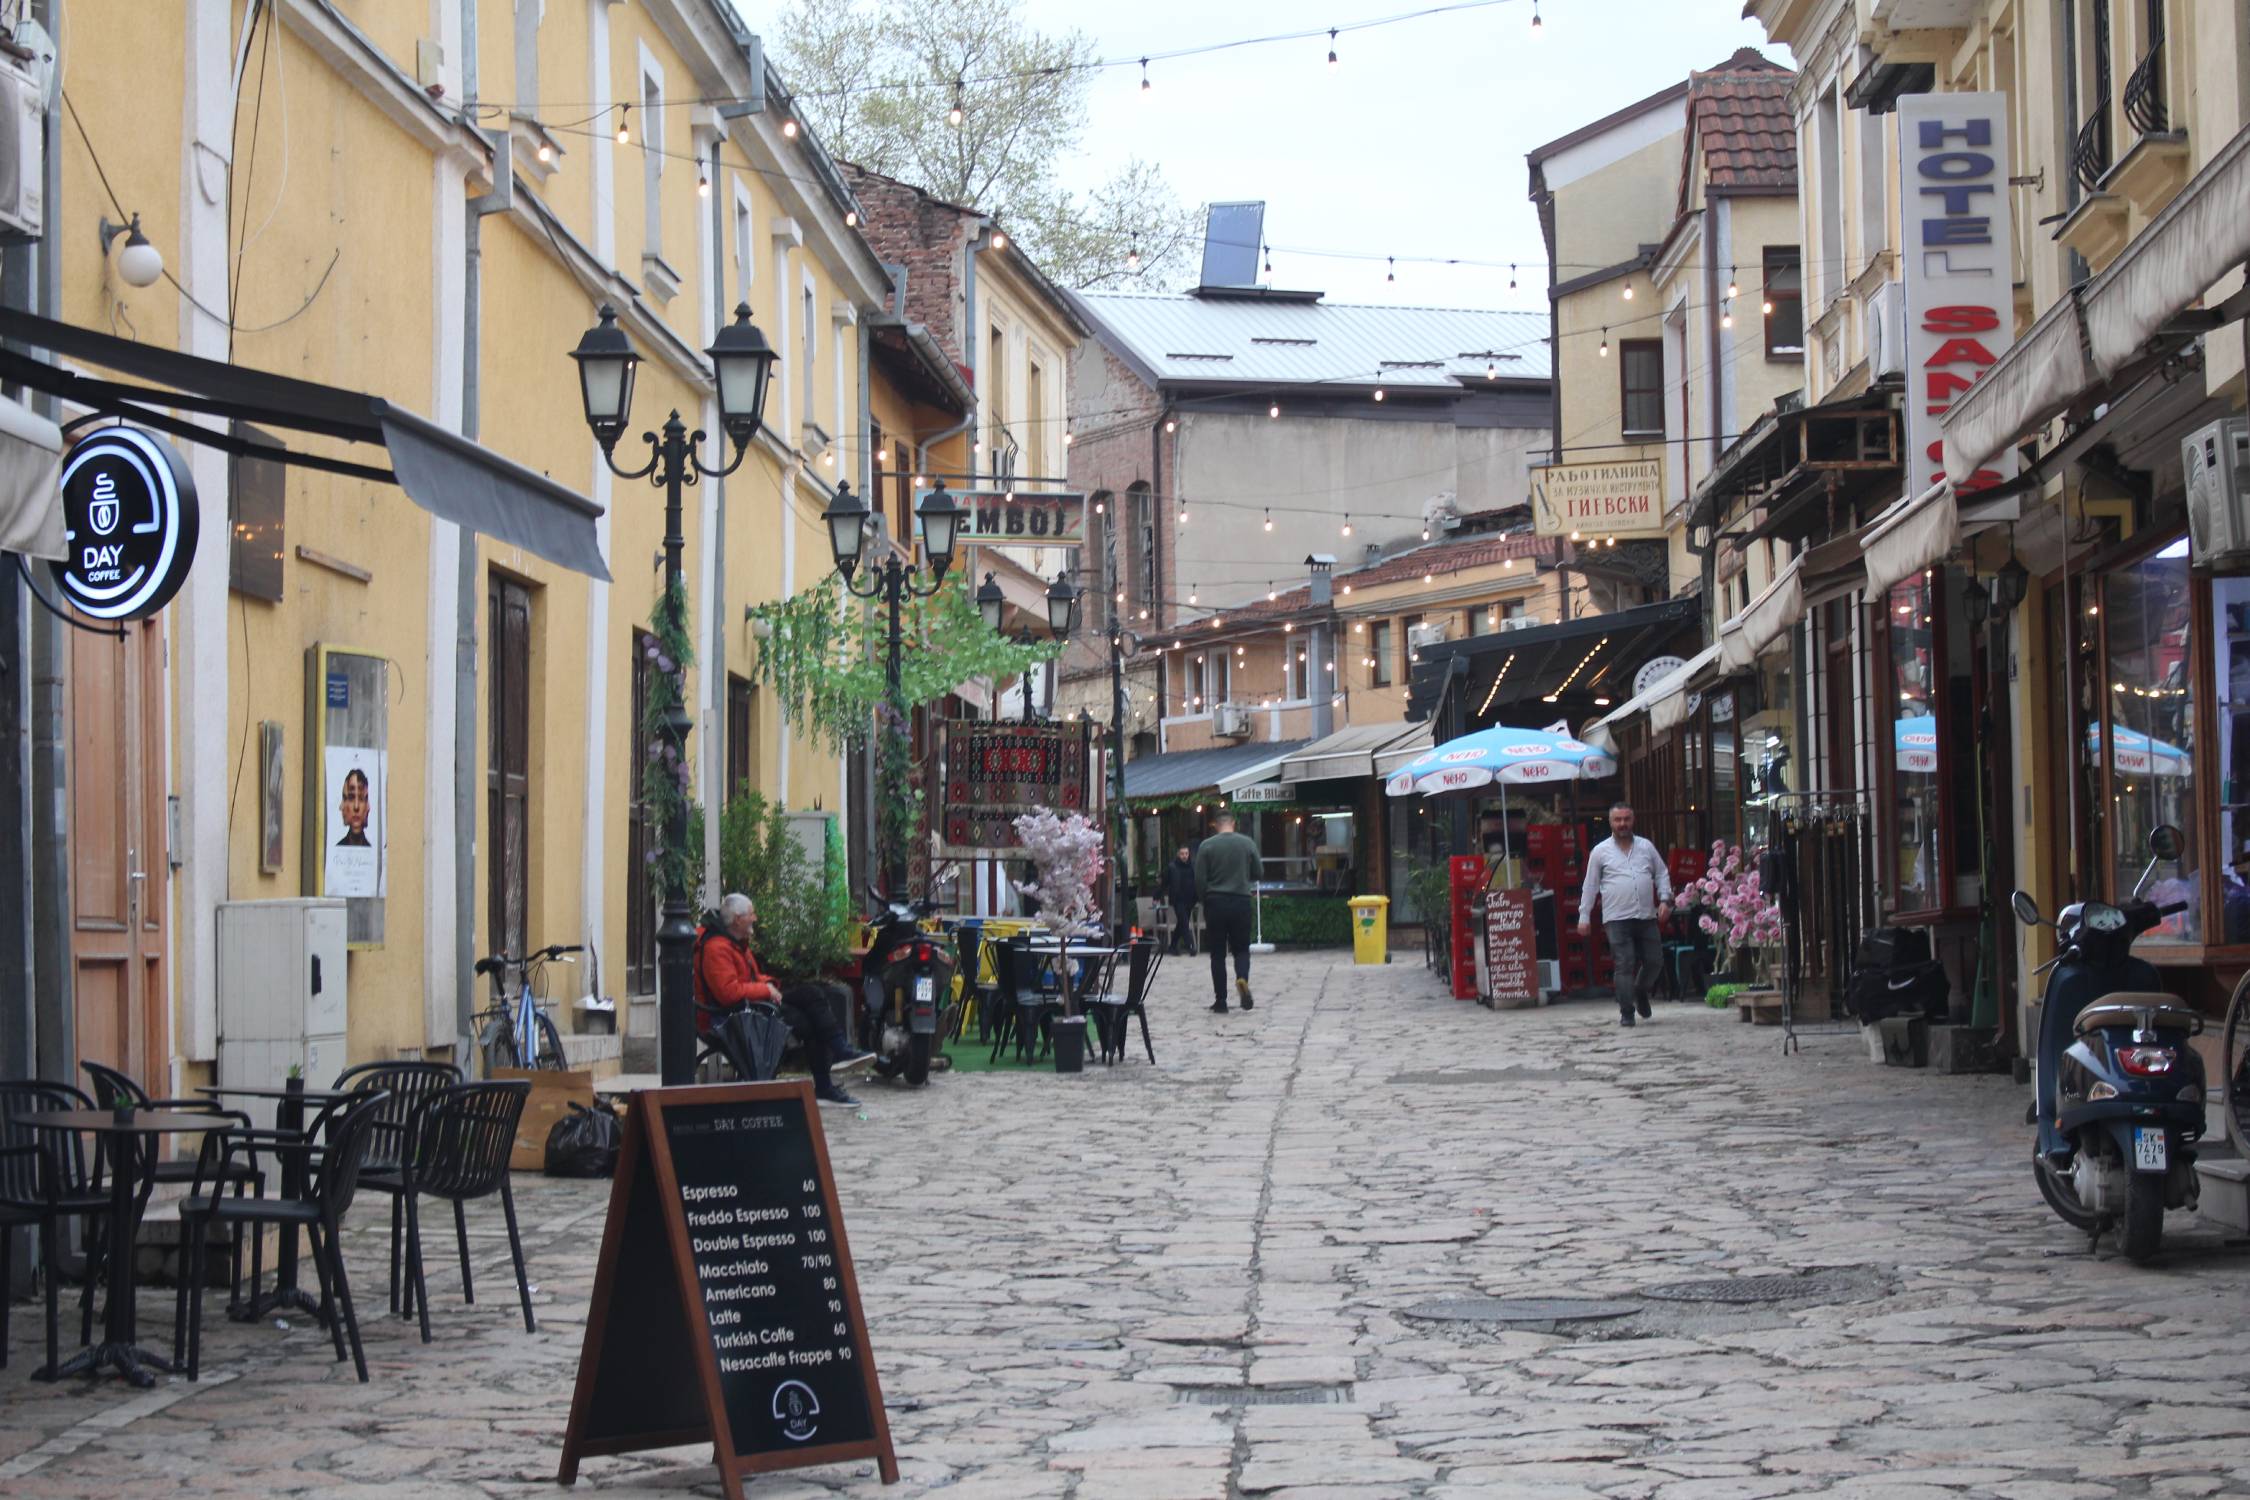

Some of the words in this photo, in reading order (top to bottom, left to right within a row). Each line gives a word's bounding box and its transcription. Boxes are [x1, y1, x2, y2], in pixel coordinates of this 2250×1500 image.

[1918, 119, 1994, 279] HOTEL
[1568, 495, 1649, 517] ГИЕВСКИ
[84, 544, 124, 569] DAY
[88, 569, 120, 582] COFFEE
[714, 1118, 735, 1131] DAY
[741, 1115, 784, 1130] COFFEE
[682, 1184, 738, 1202] Espresso
[802, 1179, 815, 1193] 60
[688, 1209, 733, 1227] Freddo
[736, 1207, 789, 1224] Espresso
[802, 1204, 821, 1218] 100
[693, 1234, 740, 1253] Double
[742, 1232, 796, 1250] Espresso
[807, 1229, 827, 1243] 100
[700, 1259, 769, 1279] Macchiato
[801, 1254, 832, 1270] 70/90
[706, 1284, 776, 1303] Americano
[823, 1276, 837, 1291] 80
[709, 1308, 741, 1326] Latte
[828, 1299, 842, 1313] 90
[713, 1330, 758, 1350] Turkish
[760, 1326, 795, 1344] Coffe
[833, 1322, 847, 1336] 60
[720, 1352, 786, 1373] Nesacaffe
[788, 1348, 833, 1367] Frappe
[838, 1347, 852, 1361] 90
